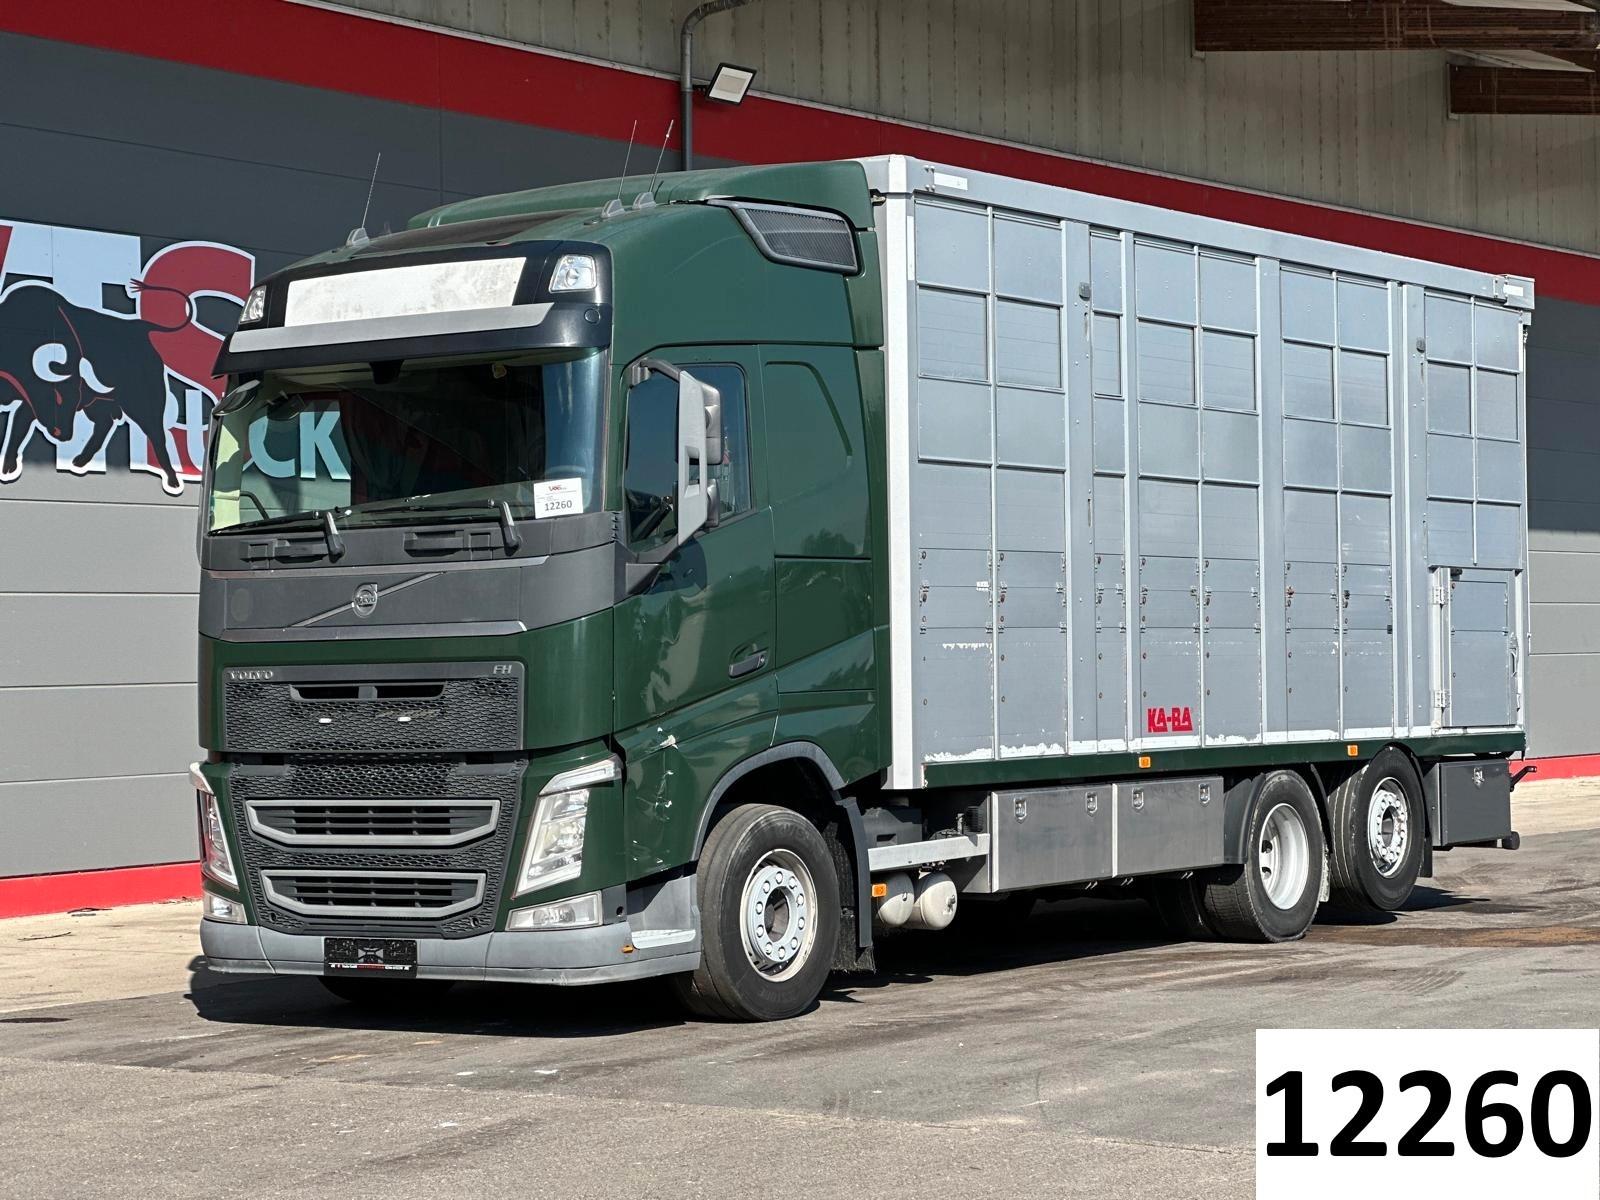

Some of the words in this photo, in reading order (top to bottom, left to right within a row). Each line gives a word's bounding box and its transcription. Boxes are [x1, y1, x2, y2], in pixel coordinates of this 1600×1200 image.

[544, 500, 573, 511] 12260
[228, 669, 273, 680] VOLVO
[493, 664, 512, 674] FH
[1147, 706, 1193, 733] KA-BA
